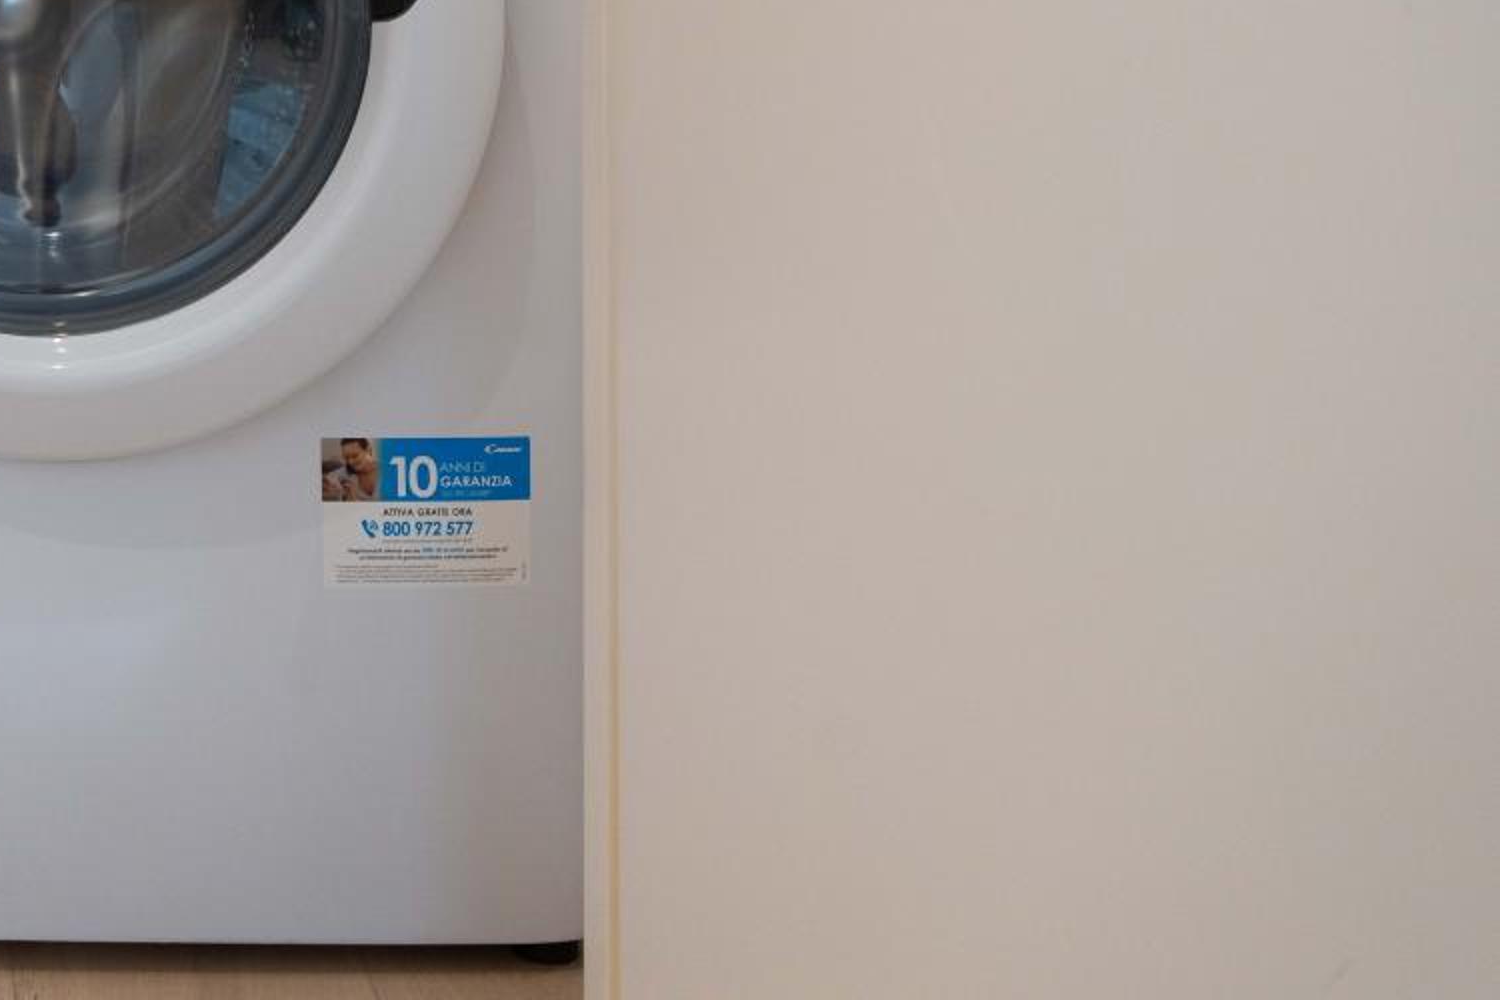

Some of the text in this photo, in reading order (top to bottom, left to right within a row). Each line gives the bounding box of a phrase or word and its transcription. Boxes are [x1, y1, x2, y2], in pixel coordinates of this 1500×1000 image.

[440, 461, 485, 473] ANNI DI
[389, 455, 439, 498] 10
[439, 475, 513, 488] GARANZIA
[383, 507, 414, 517] ATTIVA
[451, 507, 473, 517] ORA
[383, 521, 473, 536] 800 972 577
